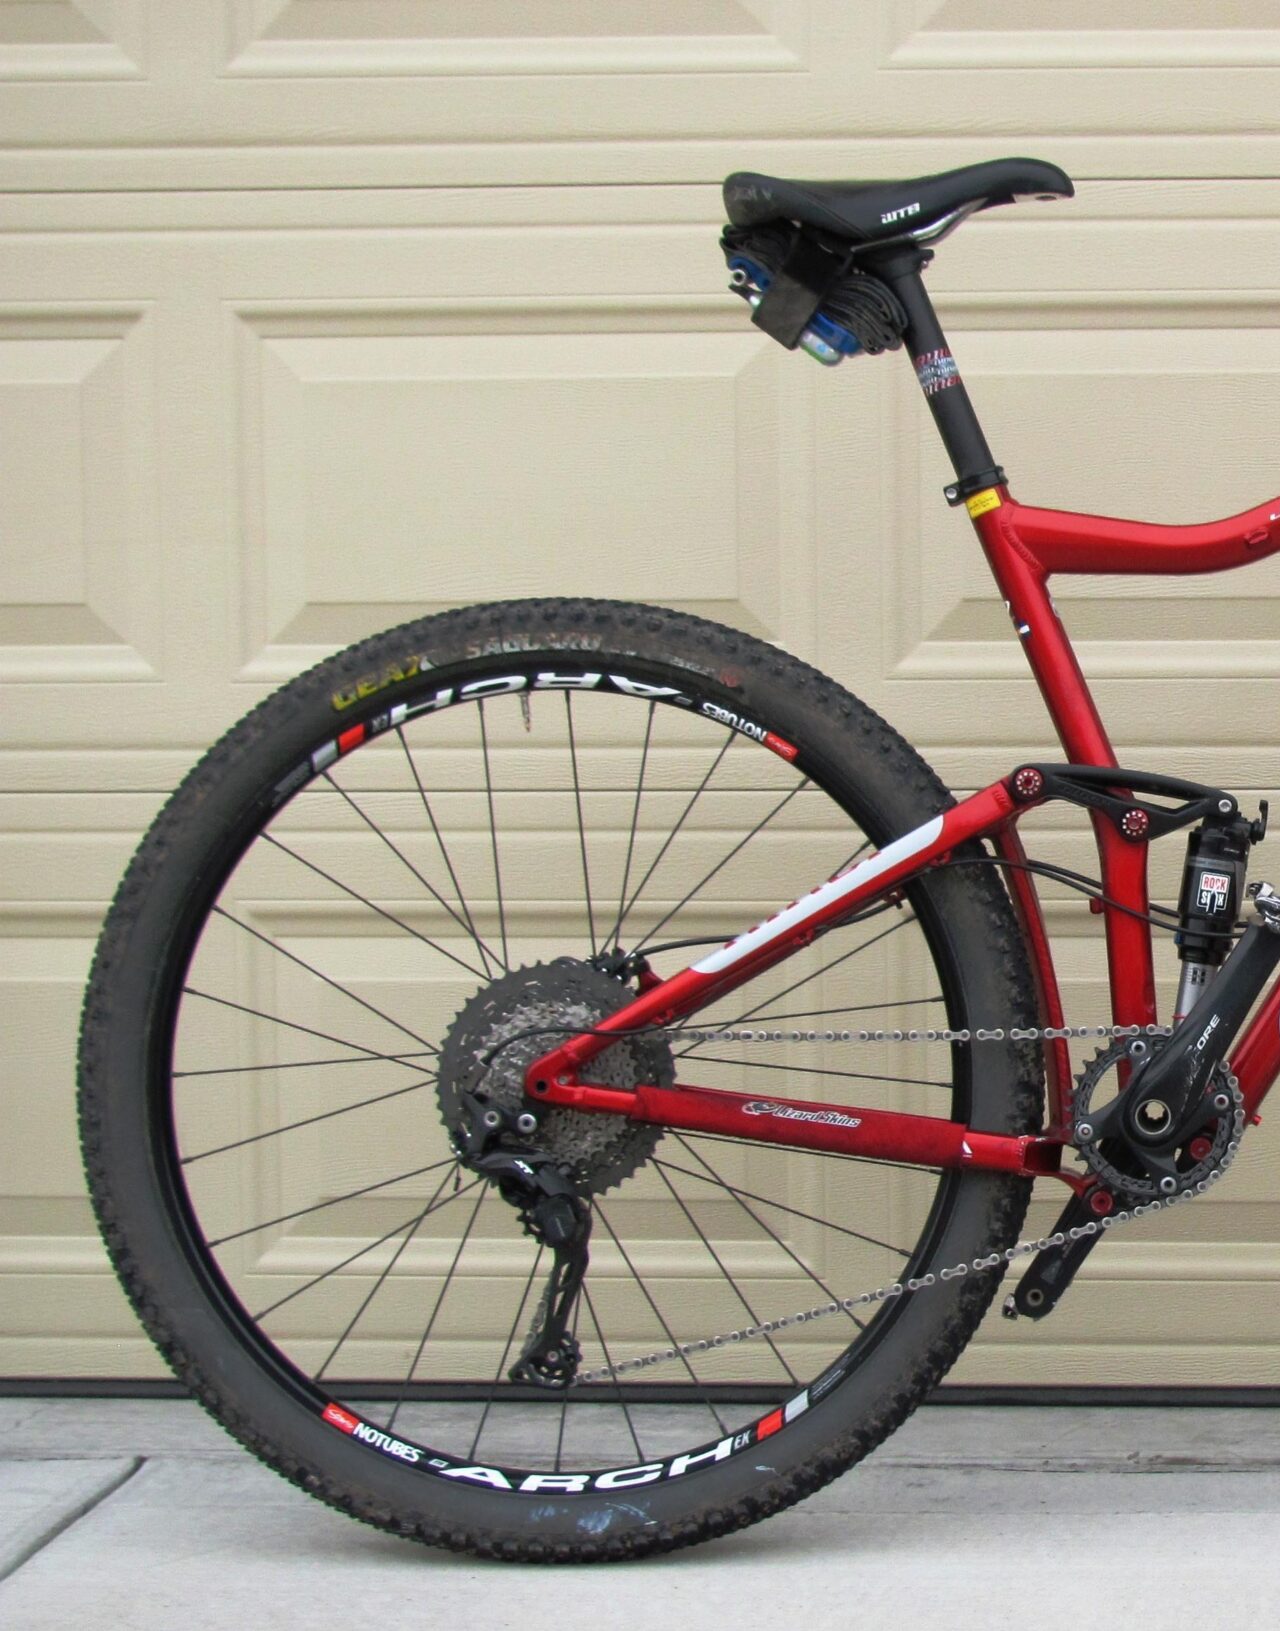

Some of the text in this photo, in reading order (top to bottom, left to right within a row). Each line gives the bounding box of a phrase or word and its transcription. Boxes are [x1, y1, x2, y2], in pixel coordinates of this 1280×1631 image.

[880, 201, 921, 225] WTB
[1203, 876, 1226, 890] ROCK
[773, 1104, 862, 1128] Lizard Skins
[353, 1422, 425, 1463] NOTUBES
[437, 1429, 752, 1493] ARCH EX
